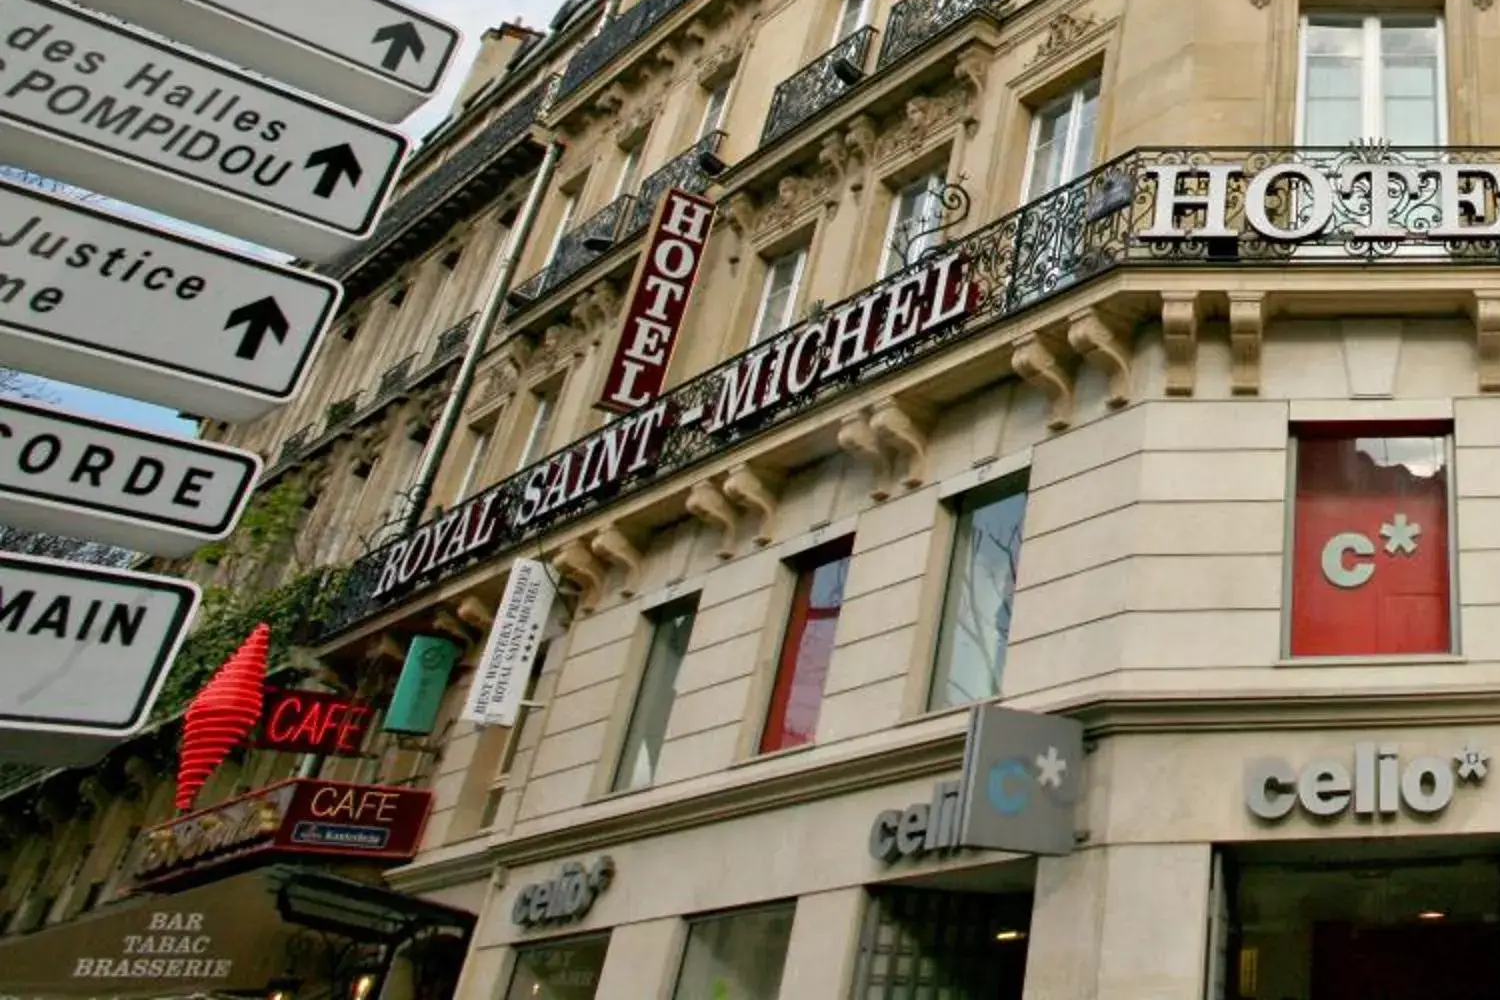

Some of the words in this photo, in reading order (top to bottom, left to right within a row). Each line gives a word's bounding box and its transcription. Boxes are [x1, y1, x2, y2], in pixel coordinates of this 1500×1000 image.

[7, 24, 106, 74] des
[124, 62, 288, 142] Halles
[4, 70, 293, 186] POMPIDOU
[0, 216, 206, 300] Justice
[610, 195, 707, 408] HOTEL
[373, 492, 499, 598] ROYAL
[270, 697, 369, 750] CAFE
[311, 787, 400, 821] CAFE
[870, 781, 962, 862] celi
[122, 936, 211, 953] TABAC
[147, 912, 204, 930] BAR
[72, 958, 233, 977] BRASSERIE
